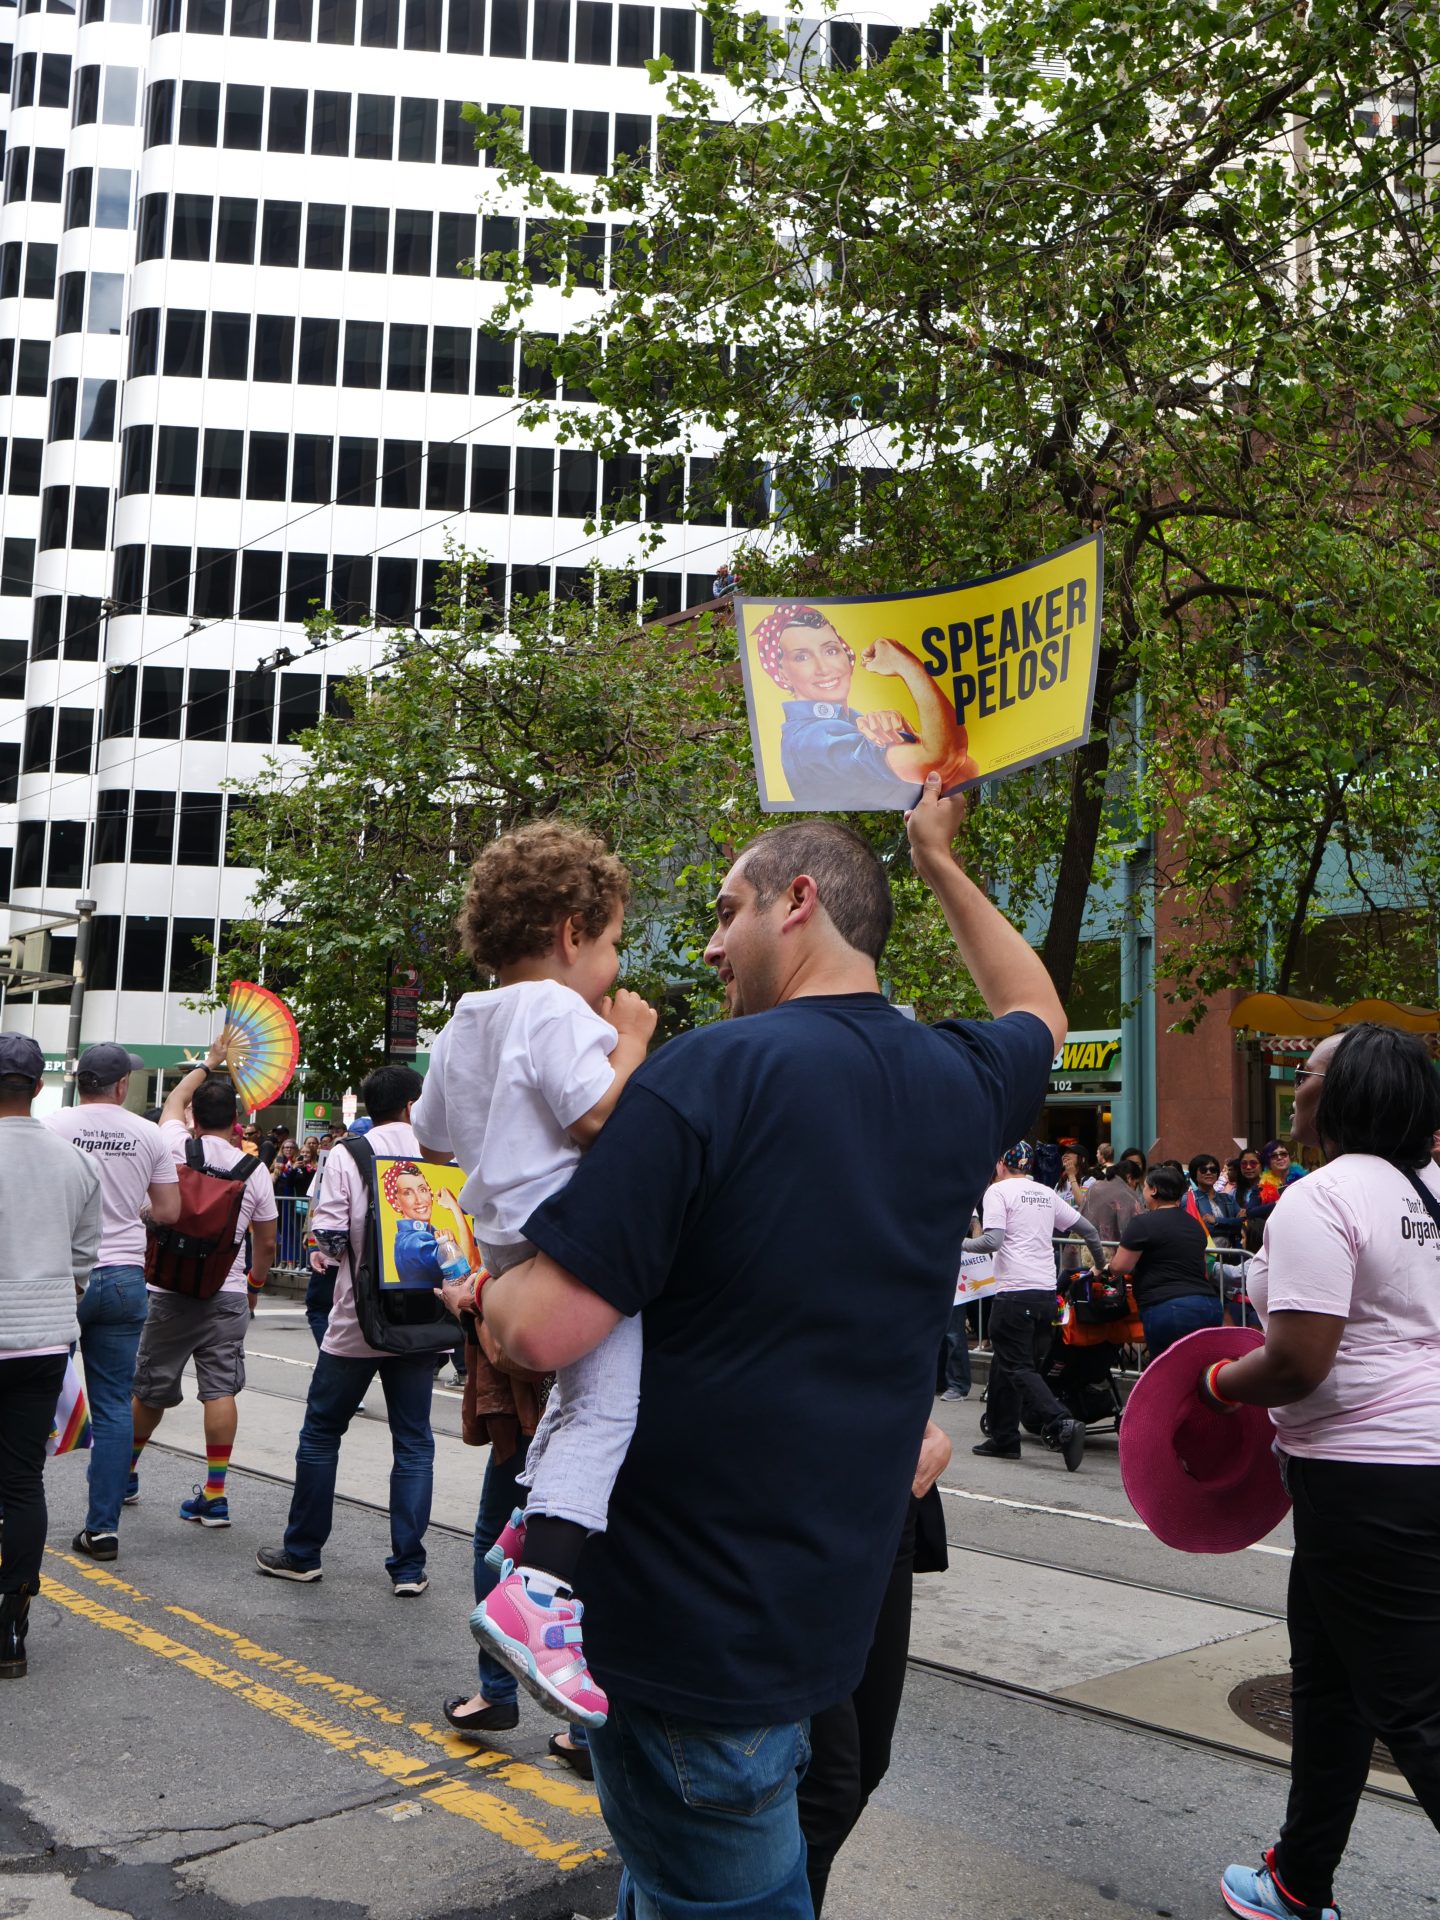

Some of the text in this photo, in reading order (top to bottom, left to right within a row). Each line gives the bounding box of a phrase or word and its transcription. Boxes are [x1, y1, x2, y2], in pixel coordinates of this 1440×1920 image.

[921, 578, 1087, 677] SPEAKER
[952, 633, 1071, 726] PELOSI
[1053, 1081, 1072, 1091] 102
